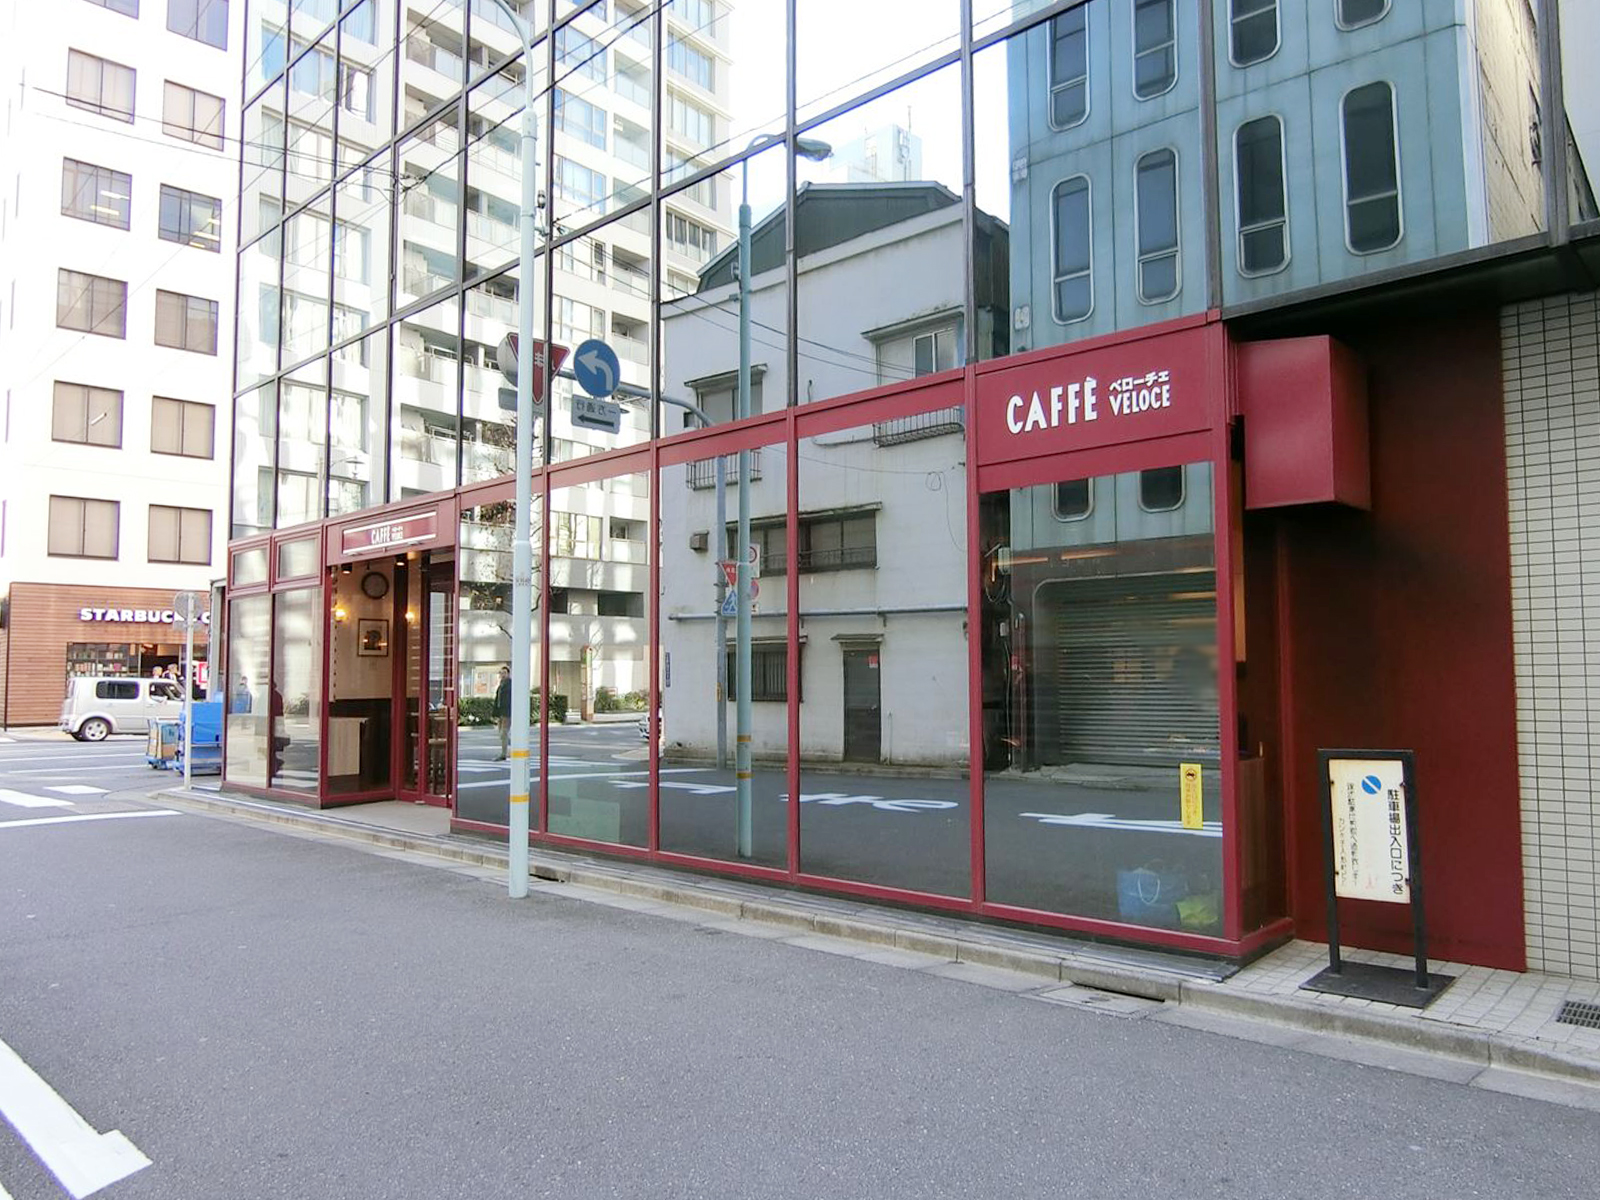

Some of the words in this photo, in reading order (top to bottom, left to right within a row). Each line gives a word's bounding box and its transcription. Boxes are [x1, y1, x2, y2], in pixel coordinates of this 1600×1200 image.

[1109, 384, 1171, 416] VELOCE
[1387, 788, 1404, 895] 駐車場出入口につき
